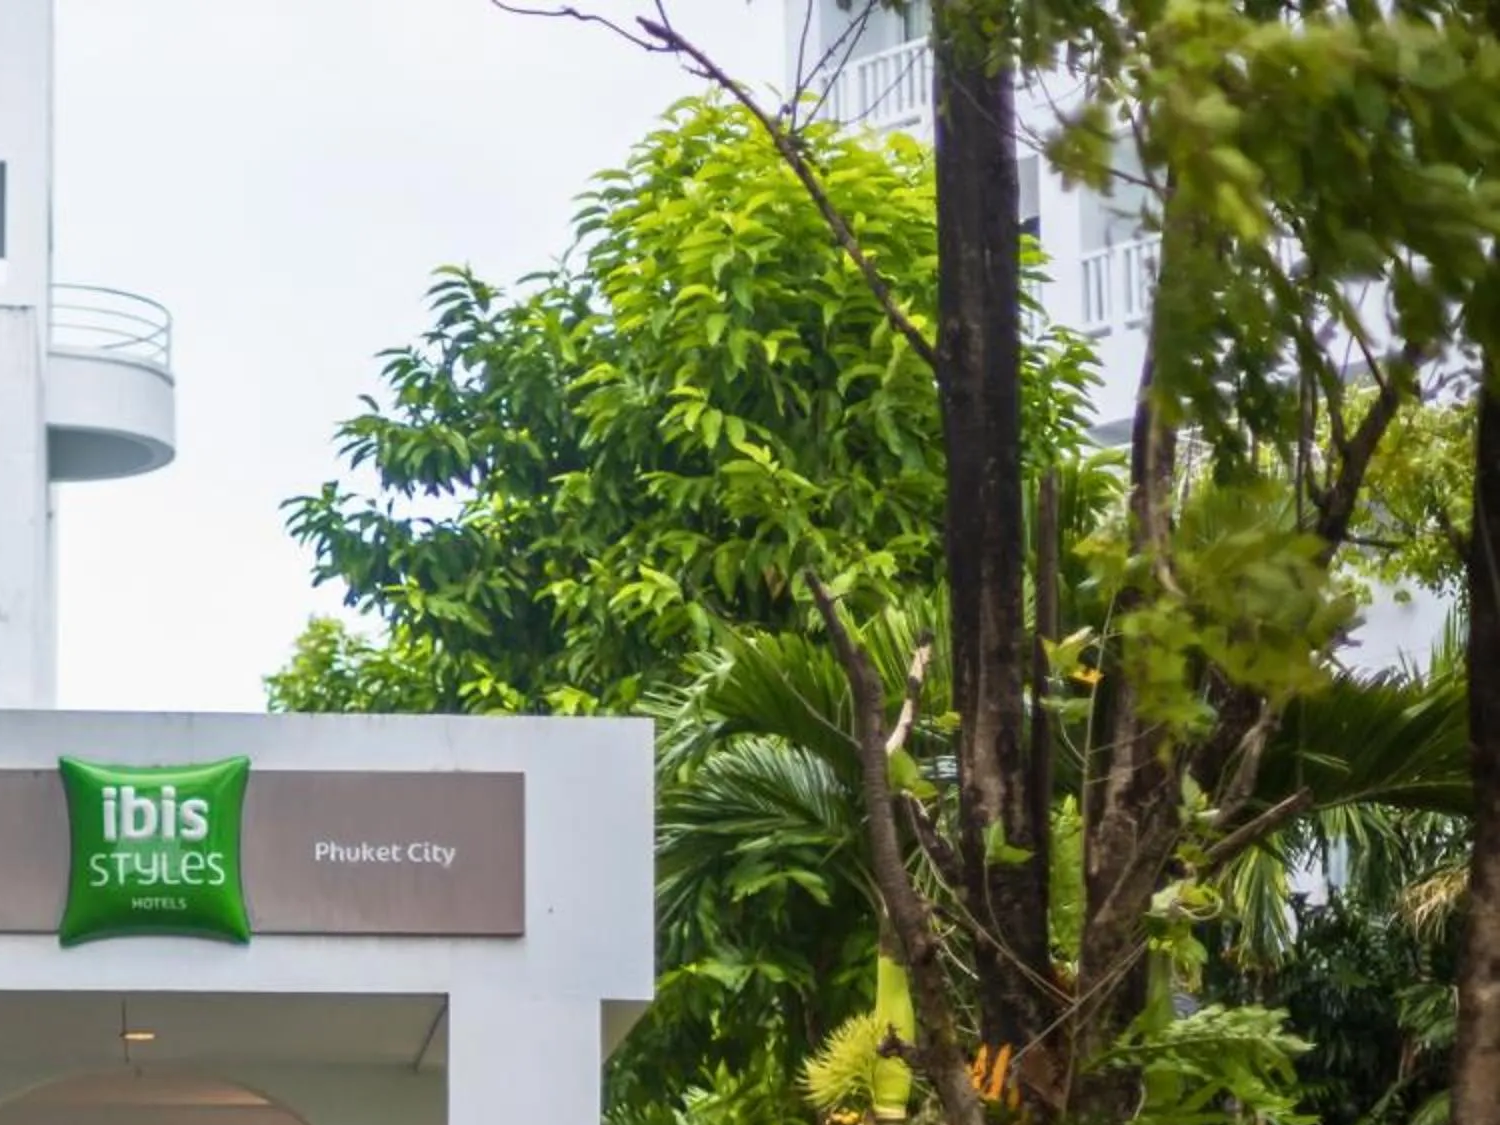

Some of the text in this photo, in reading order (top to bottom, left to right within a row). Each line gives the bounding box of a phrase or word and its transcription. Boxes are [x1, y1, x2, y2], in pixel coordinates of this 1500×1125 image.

[102, 785, 208, 841] ibis
[314, 841, 456, 869] Phuket City
[131, 897, 187, 911] HOTELS
